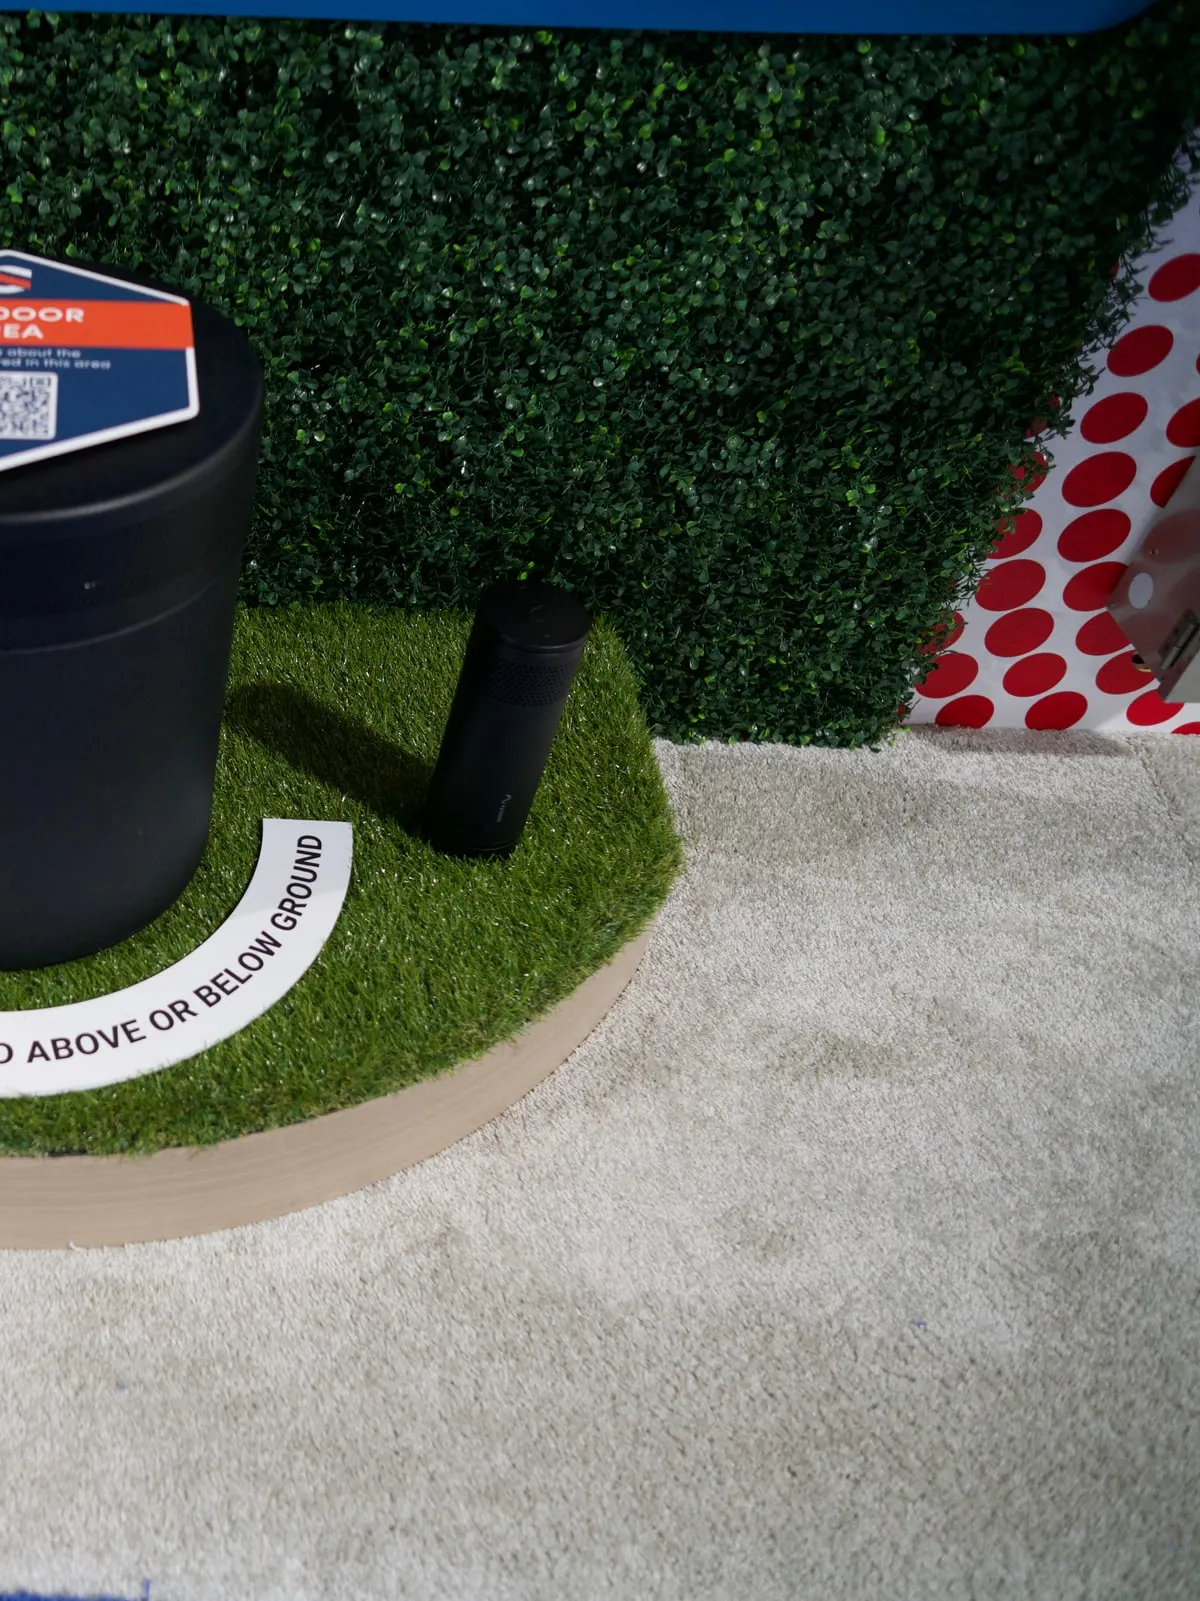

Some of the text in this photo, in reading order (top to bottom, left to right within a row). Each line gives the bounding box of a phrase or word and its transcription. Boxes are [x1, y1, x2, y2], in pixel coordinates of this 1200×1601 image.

[7, 347, 51, 358] about
[57, 347, 81, 359] the
[25, 357, 40, 367] in
[44, 357, 70, 368] this
[74, 358, 111, 370] area
[27, 1019, 147, 1063] ABOVE
[149, 999, 198, 1031] OR
[193, 930, 282, 1008] BELOW
[270, 834, 323, 931] GROUND
